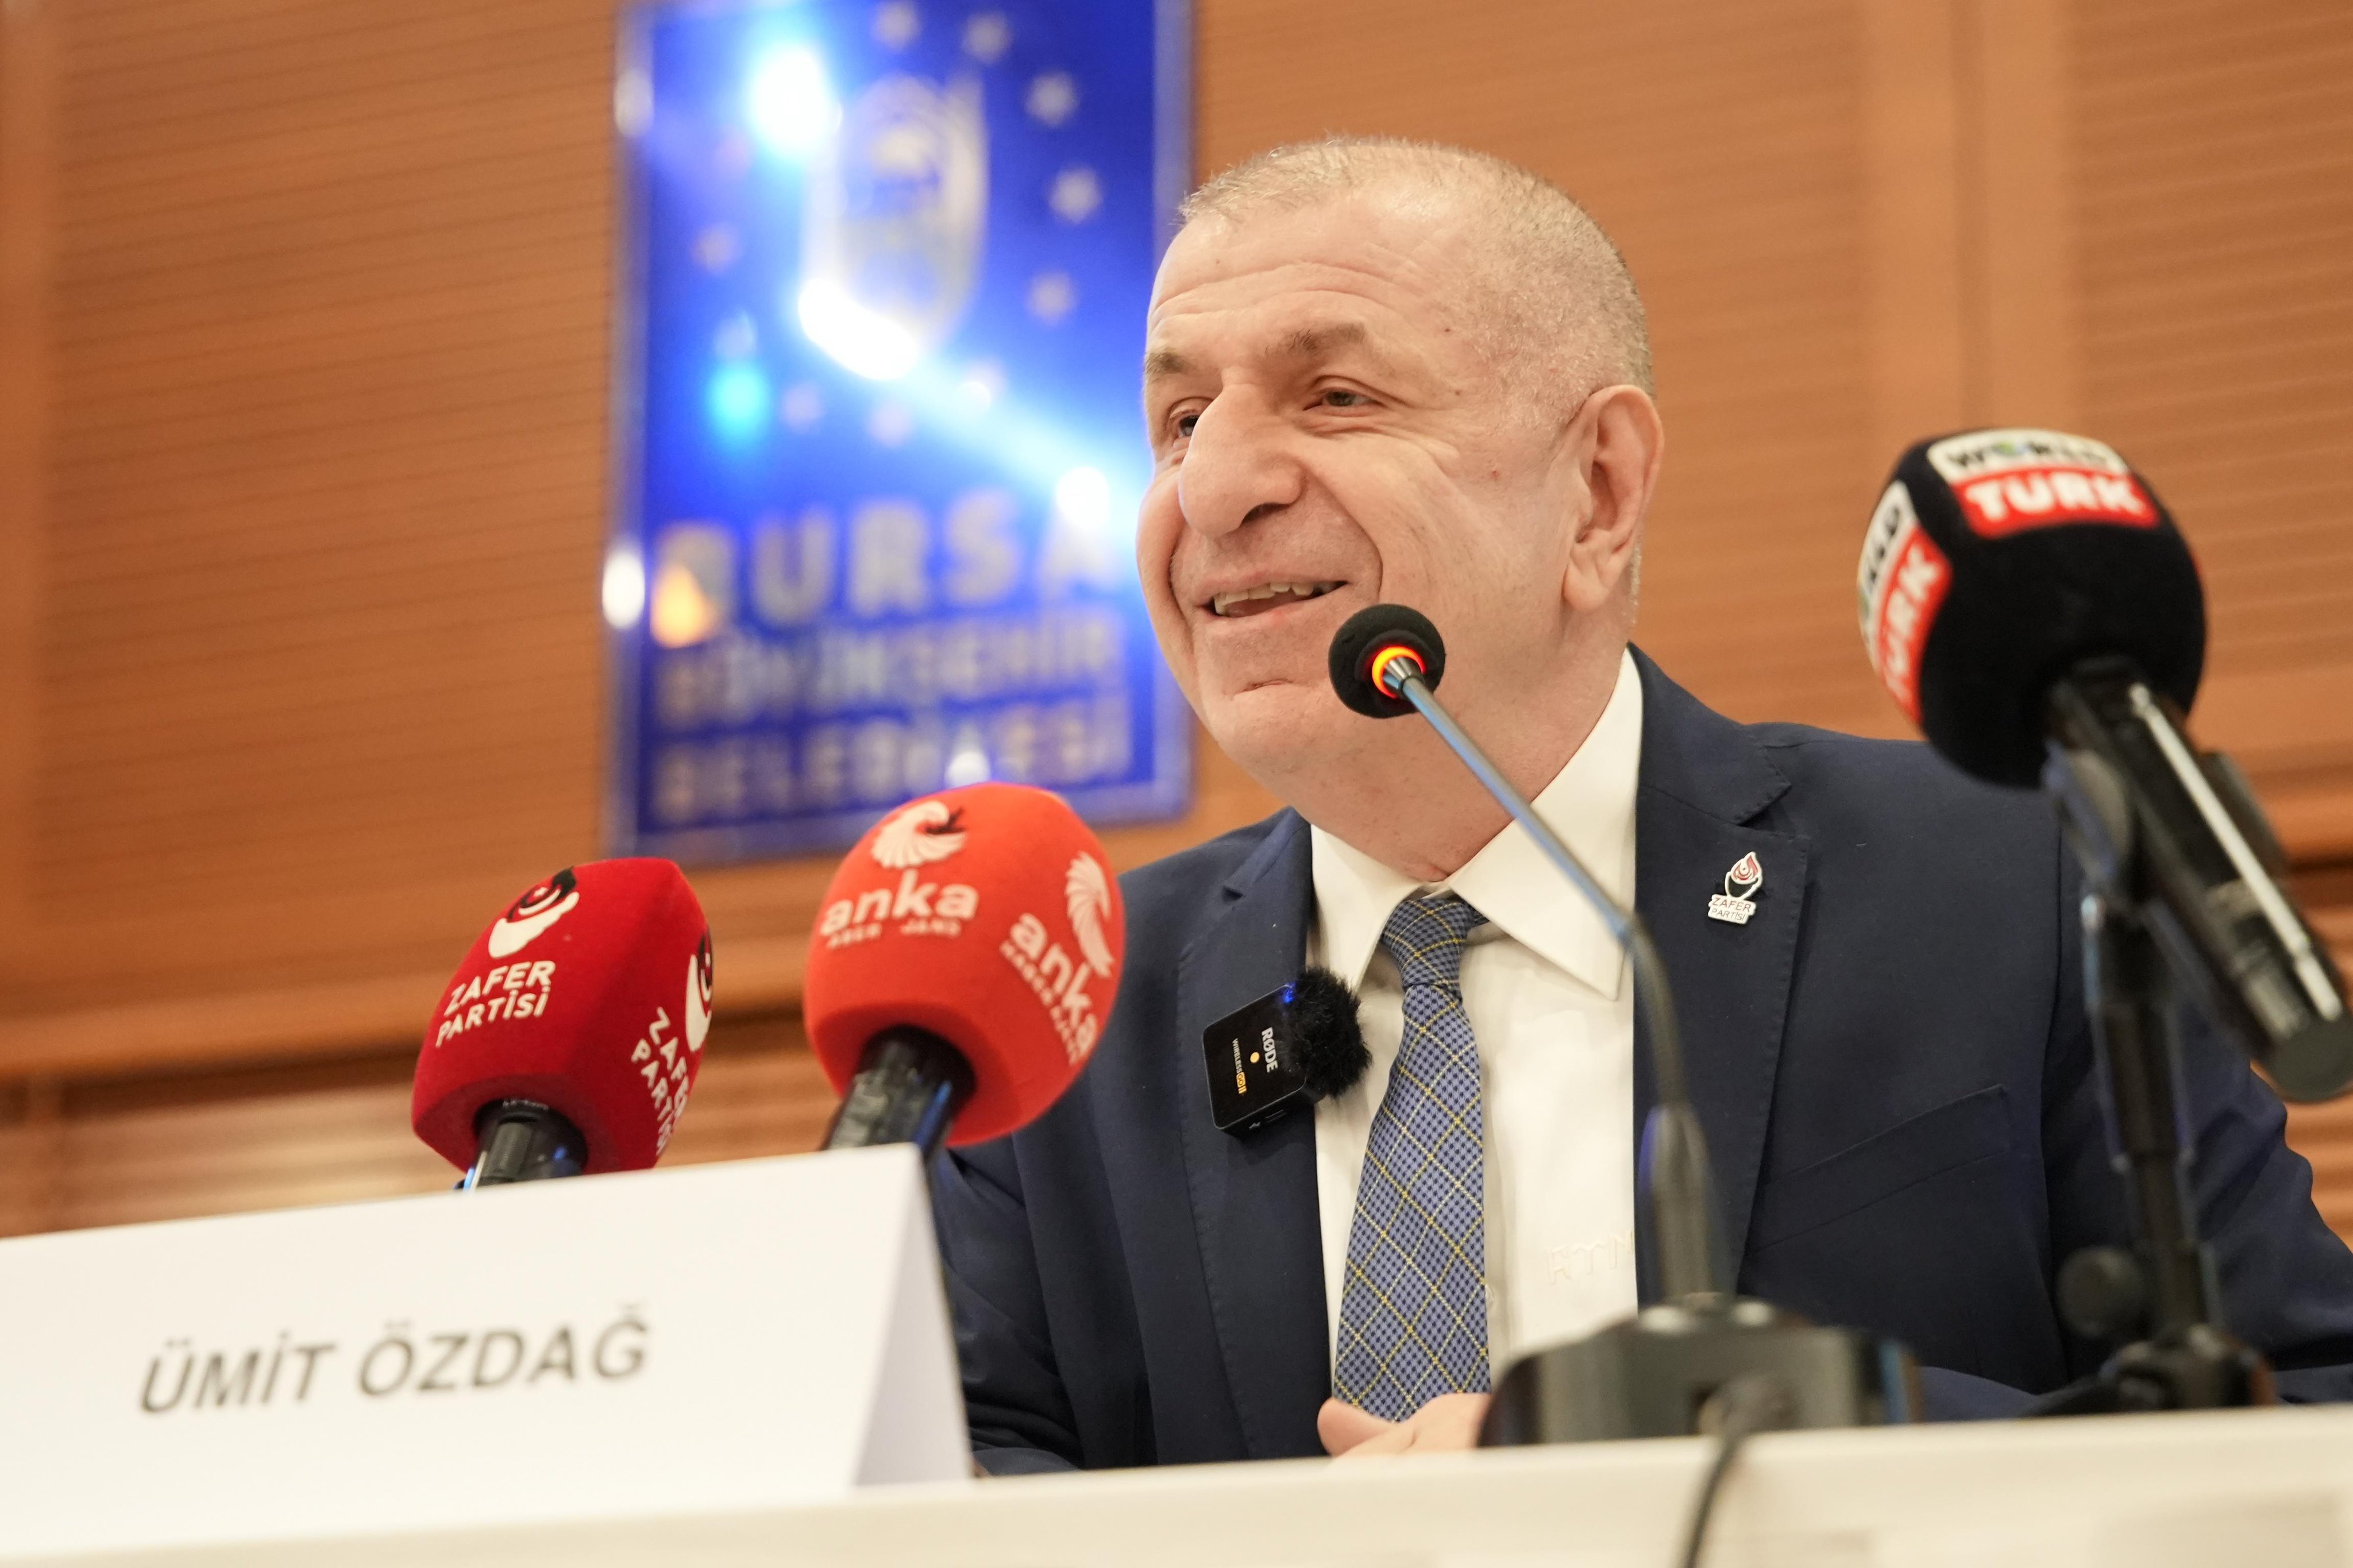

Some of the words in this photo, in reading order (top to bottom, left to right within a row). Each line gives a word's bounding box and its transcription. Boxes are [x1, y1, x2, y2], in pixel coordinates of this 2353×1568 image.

[820, 868, 978, 937] anka
[1712, 897, 1751, 912] ZAFER
[435, 986, 551, 1048] PARTİSİ
[443, 960, 556, 1017] ZAFER
[1010, 912, 1098, 1058] anka
[140, 1327, 338, 1415] ÜMİT
[357, 1301, 649, 1399] ÖZDAĞ
